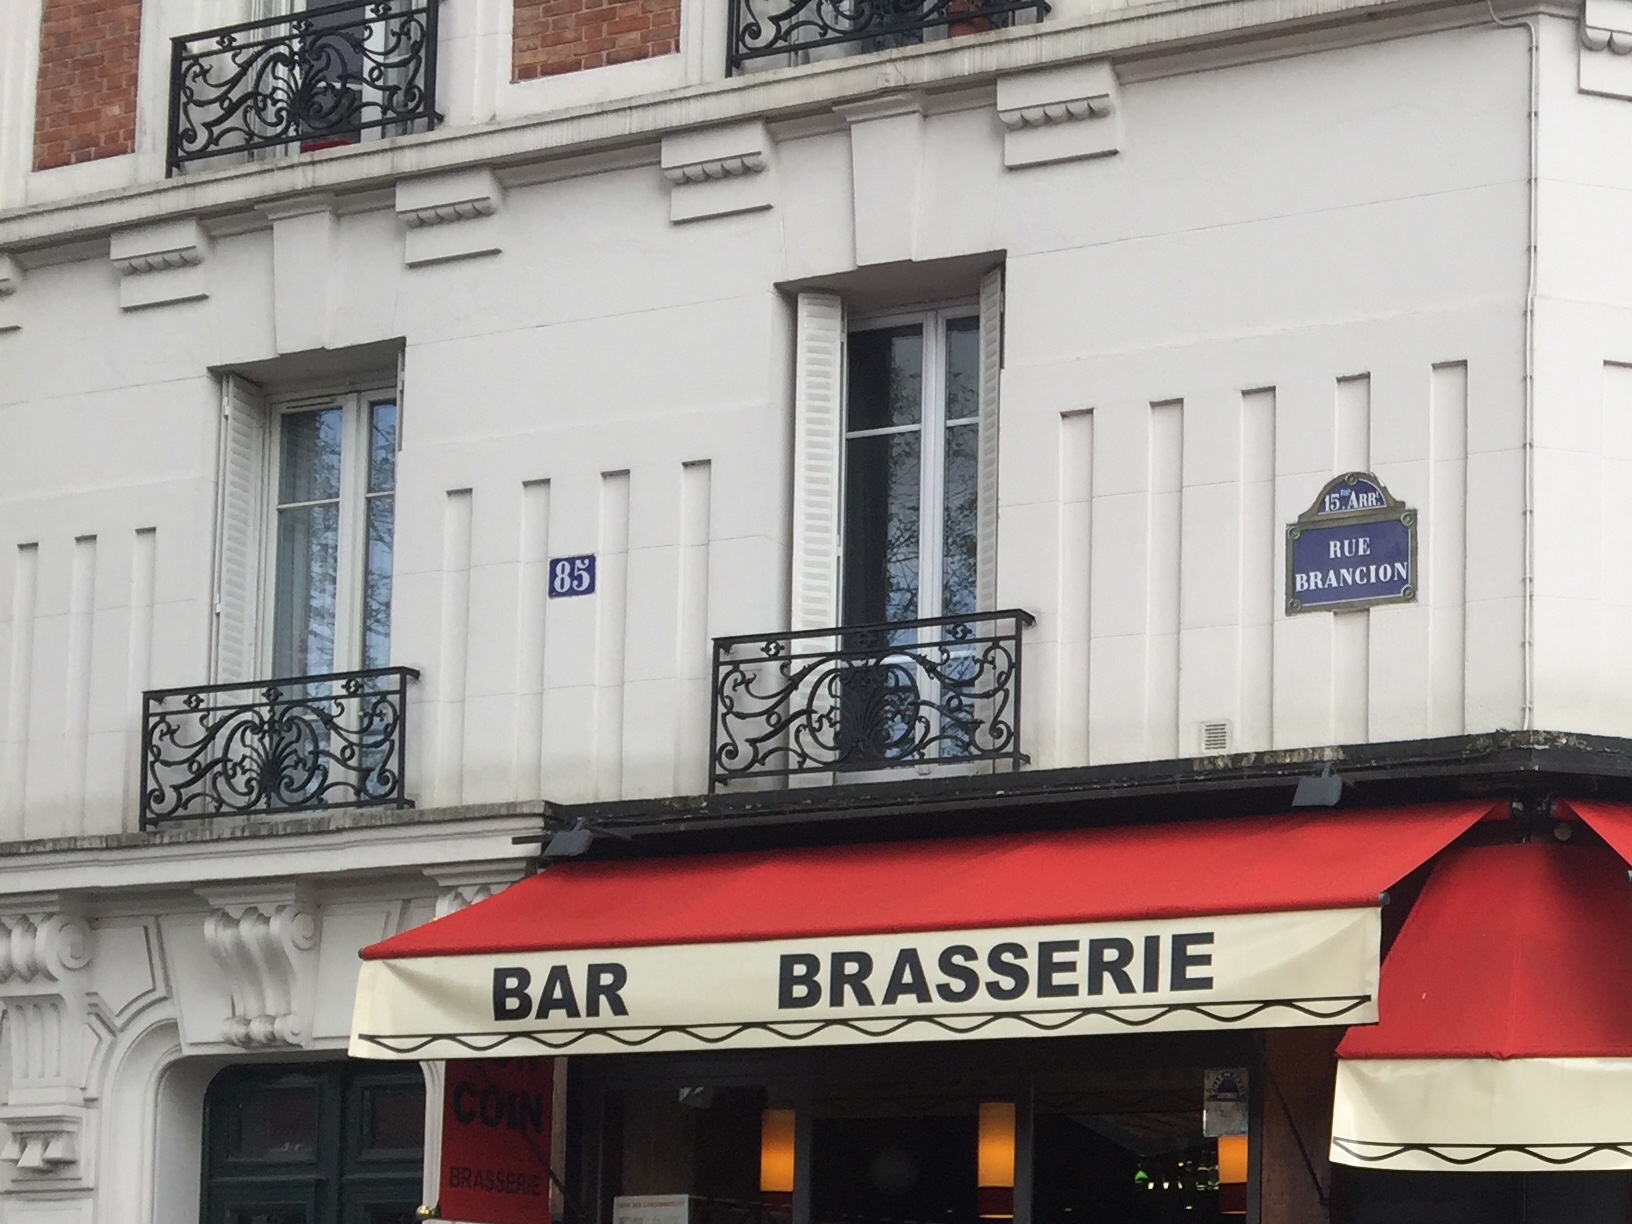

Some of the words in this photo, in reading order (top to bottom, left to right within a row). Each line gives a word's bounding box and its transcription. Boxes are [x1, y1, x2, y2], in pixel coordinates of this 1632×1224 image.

[1329, 537, 1371, 559] RUE
[553, 558, 590, 593] 85
[1295, 561, 1408, 592] BRANCION
[492, 962, 629, 1022] BAR
[777, 931, 1216, 1011] BRASSERIE
[452, 1080, 543, 1135] COIN
[449, 1166, 542, 1197] BRASSERIE
